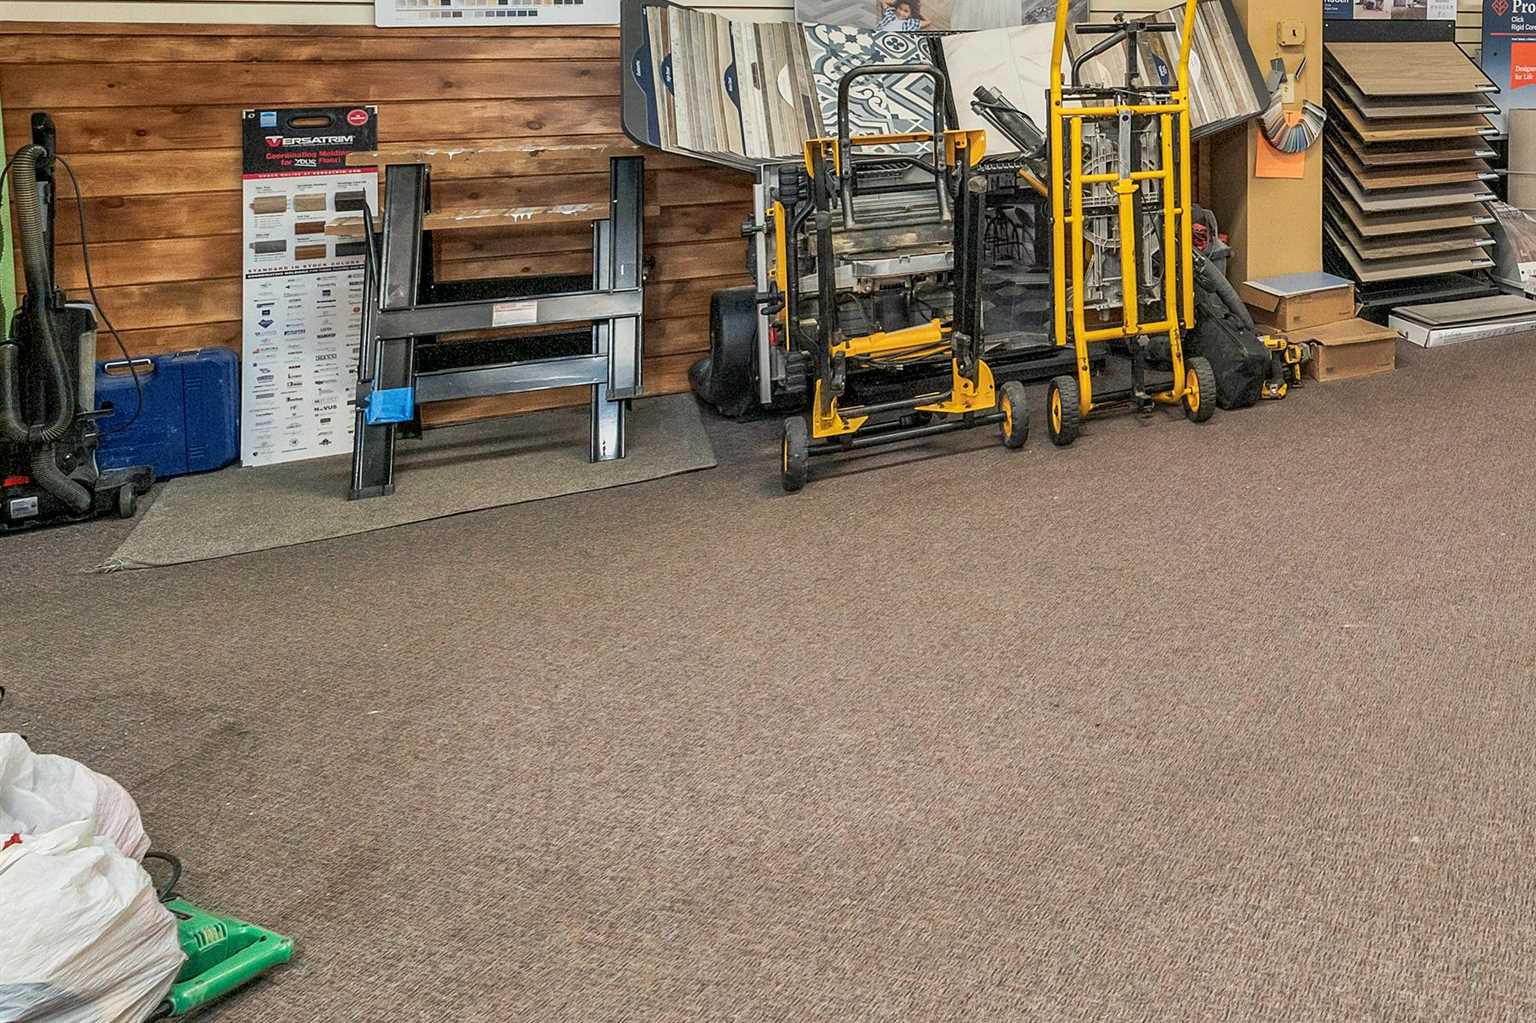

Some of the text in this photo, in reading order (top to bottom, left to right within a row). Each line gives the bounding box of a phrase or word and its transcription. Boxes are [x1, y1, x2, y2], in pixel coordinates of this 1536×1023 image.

[1511, 15, 1525, 23] Click
[1511, 23, 1525, 32] Rigid
[265, 135, 354, 147] VERSATRIM
